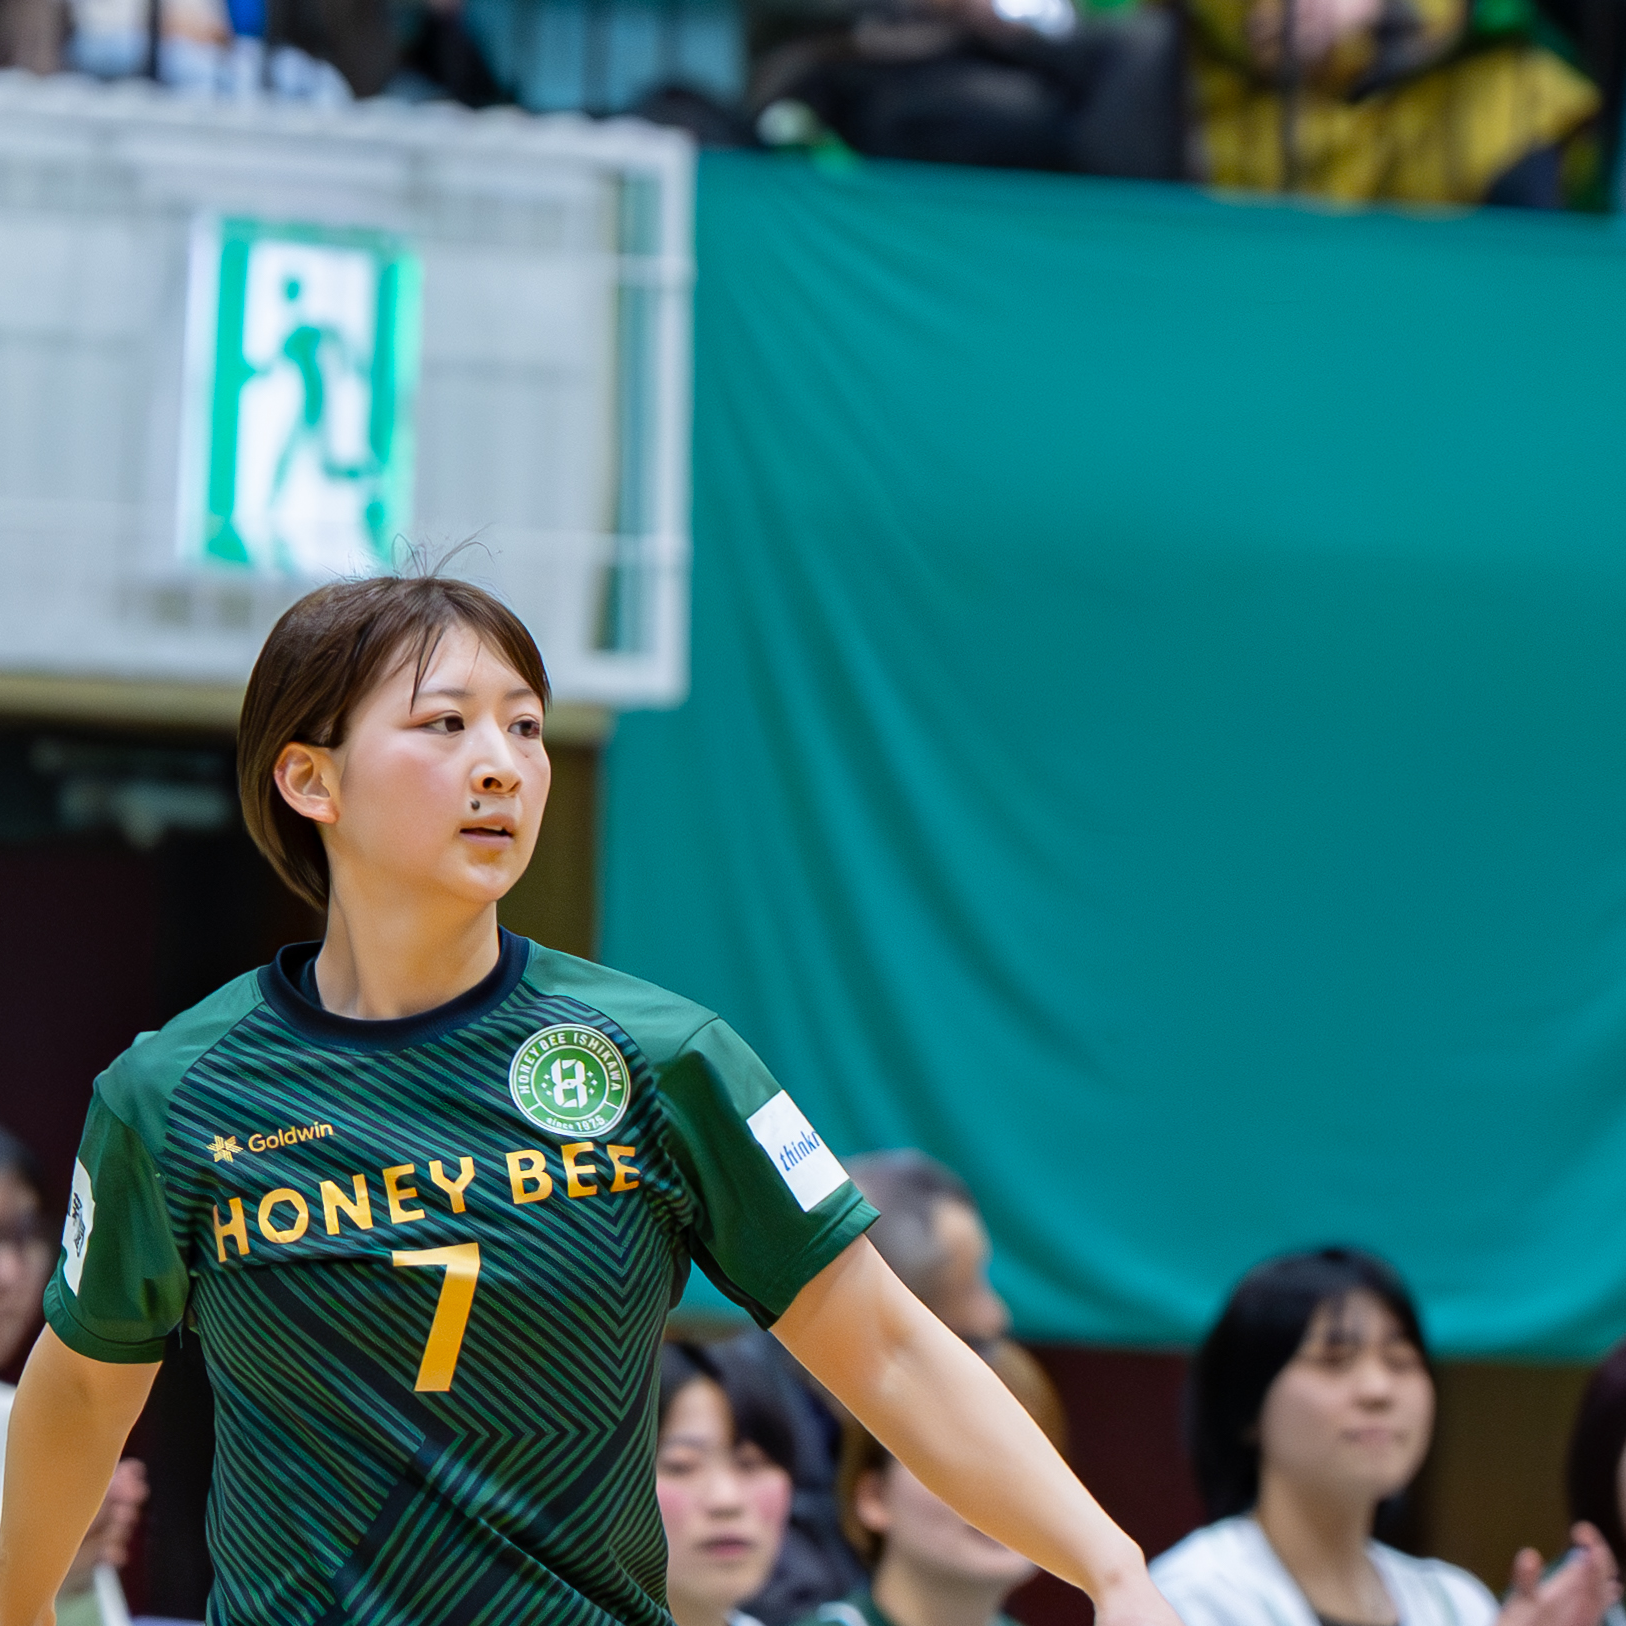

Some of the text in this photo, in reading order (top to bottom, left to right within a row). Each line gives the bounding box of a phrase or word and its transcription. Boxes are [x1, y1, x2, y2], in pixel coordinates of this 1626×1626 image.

[518, 1032, 622, 1094] HONEY BEE ISHIKAWA
[247, 1121, 334, 1153] Goldwin
[545, 1114, 606, 1131] since 1975
[212, 1141, 642, 1264] HONEY BEE
[392, 1242, 481, 1393] 7
